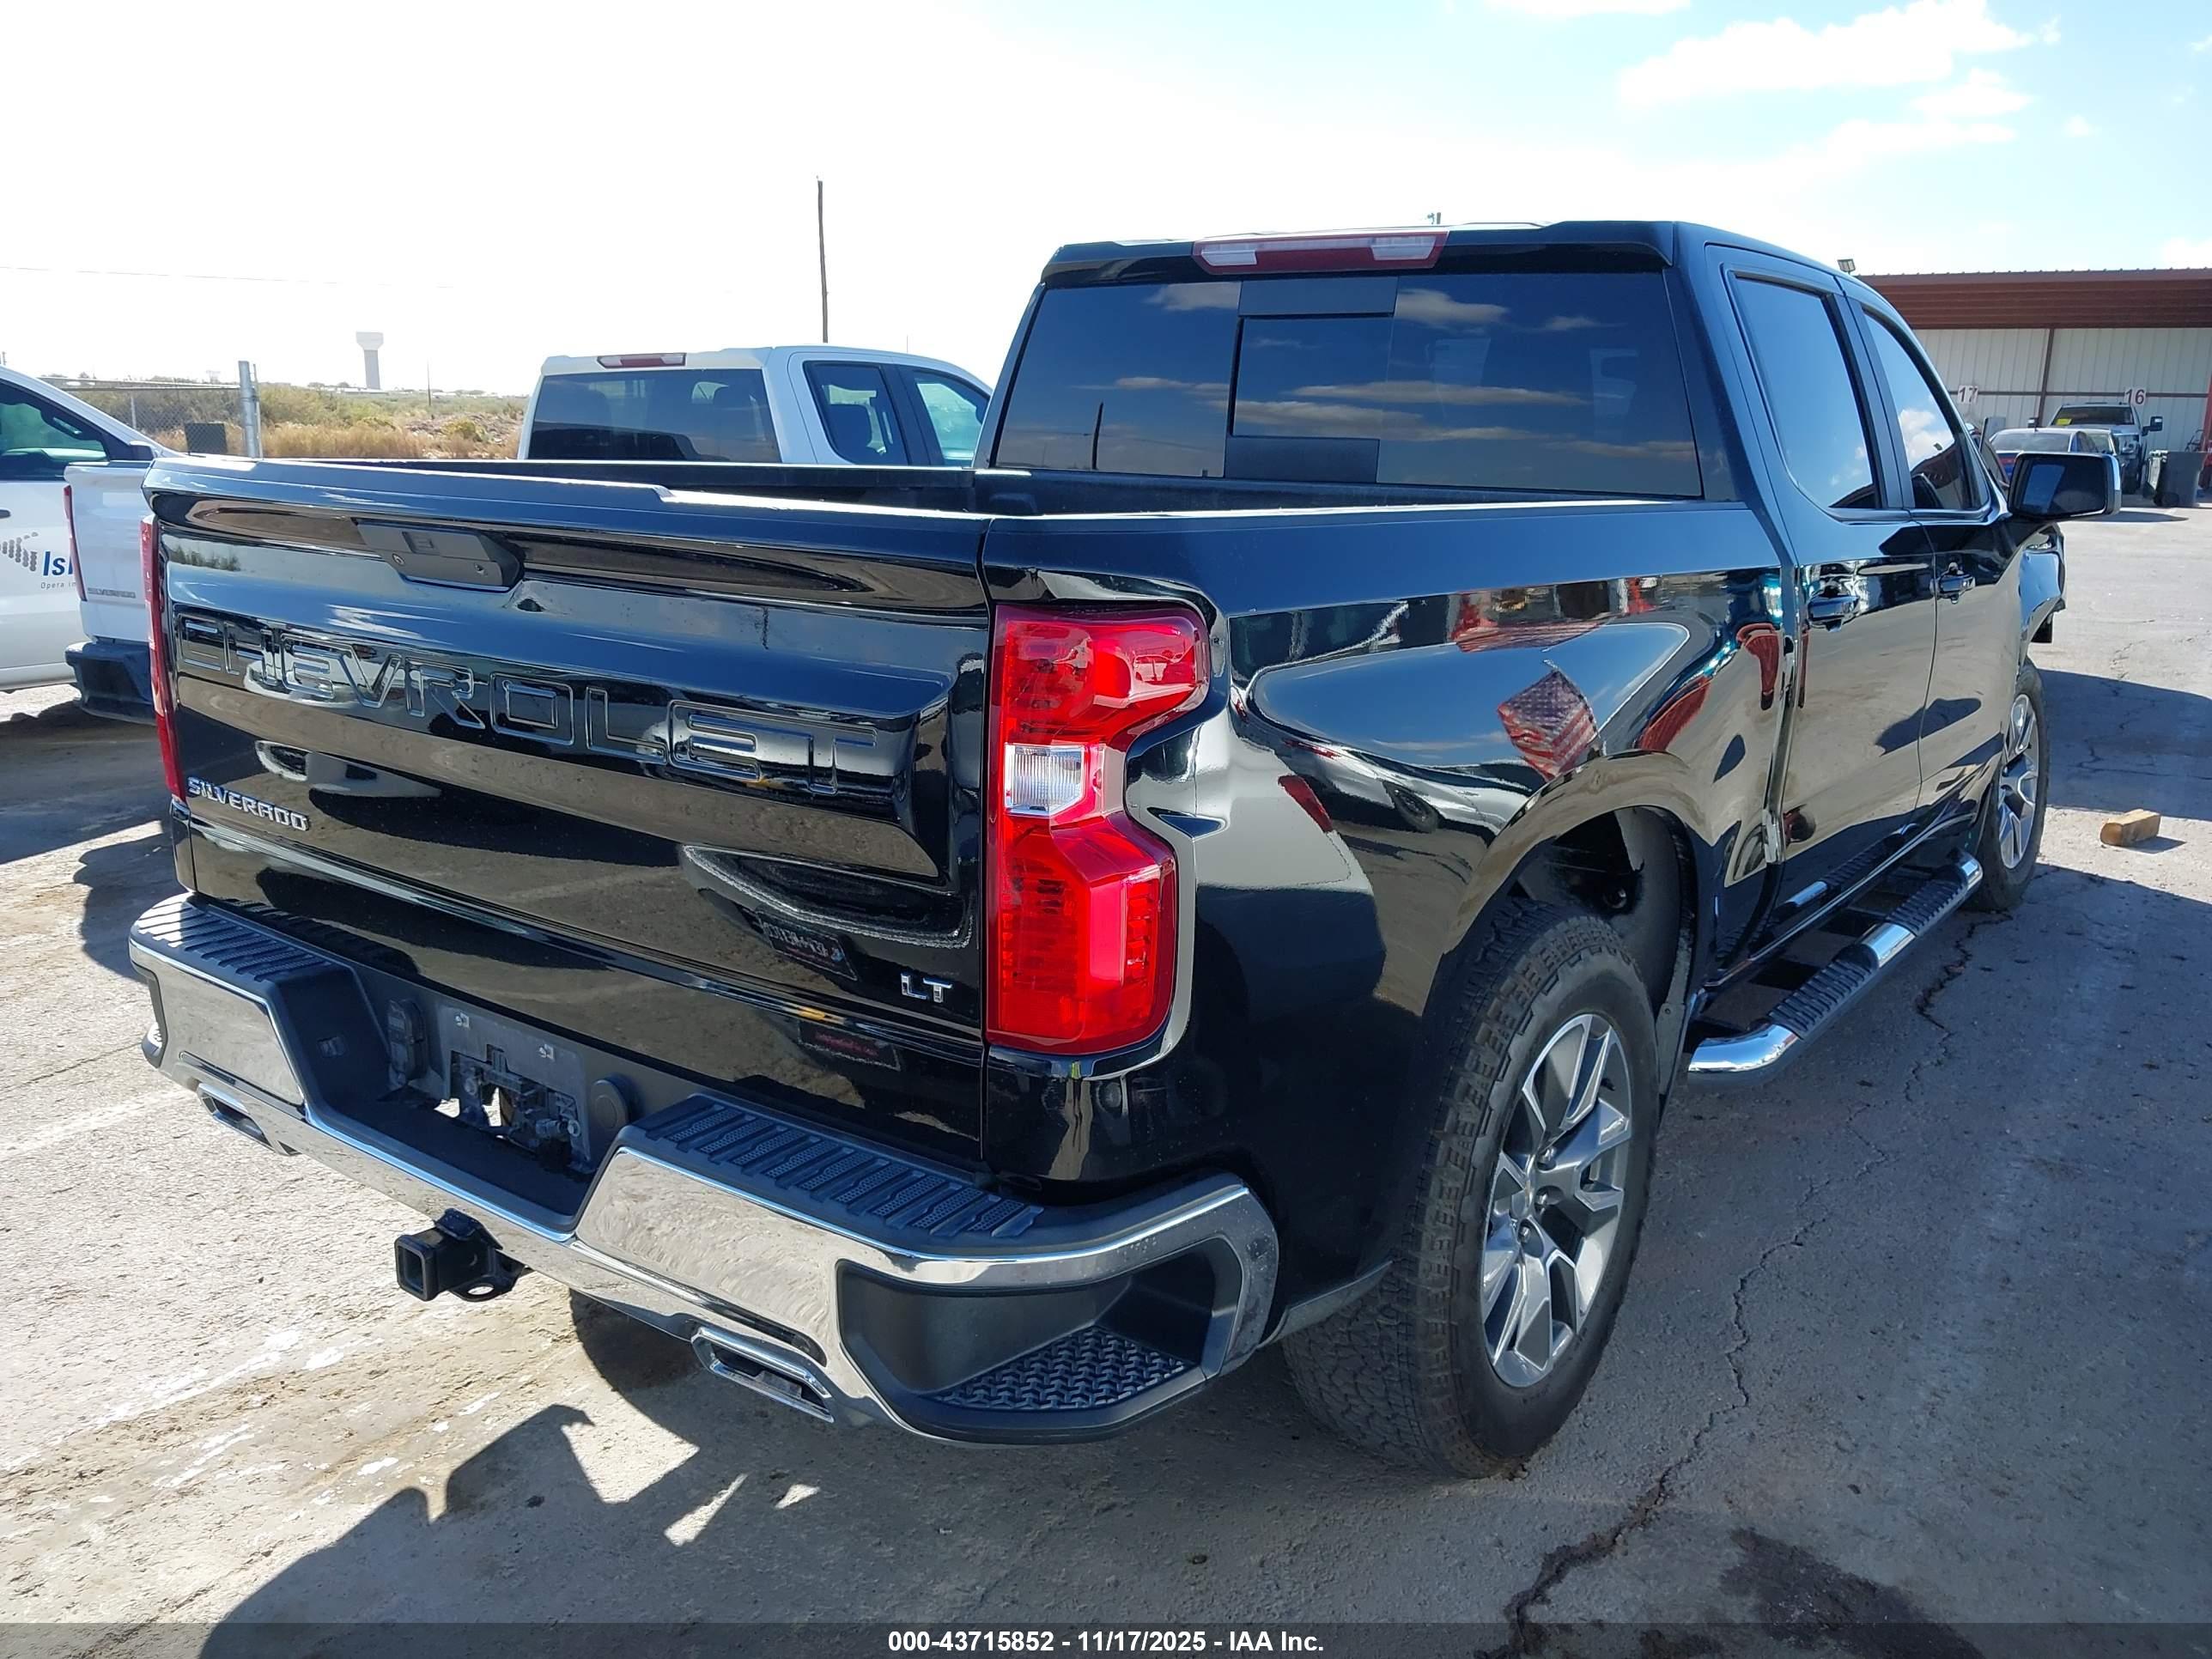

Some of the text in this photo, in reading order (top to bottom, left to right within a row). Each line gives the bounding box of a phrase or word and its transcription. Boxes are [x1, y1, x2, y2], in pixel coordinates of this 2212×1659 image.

[1958, 386, 1978, 402] 17
[2125, 388, 2145, 405] 16
[175, 612, 878, 795] CHEVROLET
[186, 775, 310, 831] SILVERADO
[901, 972, 953, 1003] LT
